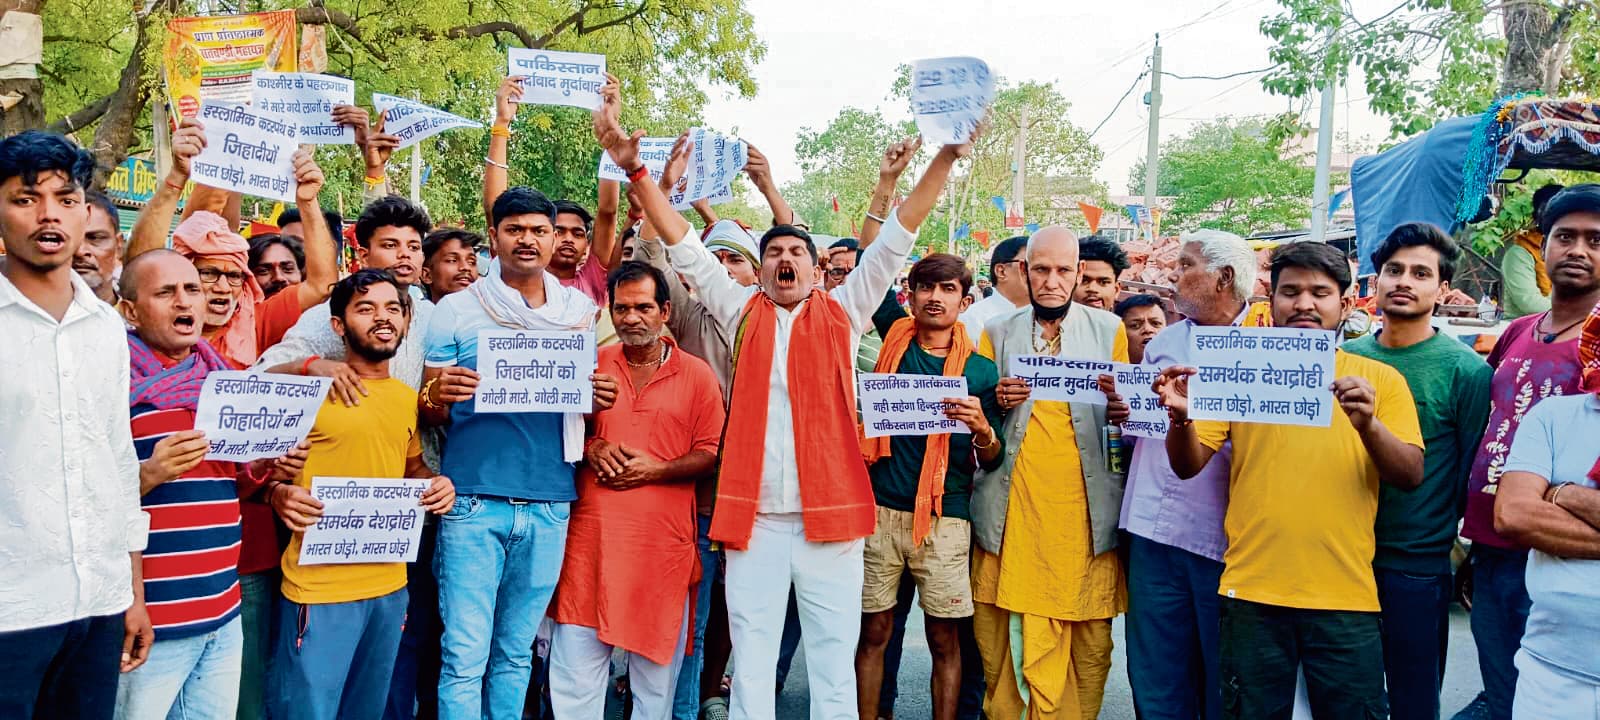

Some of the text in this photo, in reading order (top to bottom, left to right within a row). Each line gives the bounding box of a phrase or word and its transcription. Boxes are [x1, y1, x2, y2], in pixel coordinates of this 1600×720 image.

[516, 54, 600, 75] पाकिस्तान
[256, 75, 292, 89] काश्मीर
[294, 76, 304, 89] के
[204, 104, 257, 127] इस्लामिक
[288, 122, 297, 138] के
[223, 133, 279, 164] जिहादीयों
[194, 161, 219, 178] भारत
[249, 173, 270, 189] भारत
[272, 176, 289, 195] छोड़ो
[488, 333, 584, 351] इस्लामिक कटरपंथी
[1196, 330, 1330, 352] इस्लामिक कटरपंथ के
[495, 359, 576, 380] जिहादीयों को
[1117, 367, 1151, 385] काश्मिर
[1198, 361, 1324, 389] समर्थक देशद्रोही
[215, 375, 320, 398] इस्लामिक कटरपंथी
[864, 376, 960, 392] इस्लामिक आतंकवाद
[482, 388, 506, 404] गोली
[534, 387, 559, 404] गोली
[561, 389, 582, 404] मारो
[1129, 392, 1142, 410] के
[891, 400, 915, 413] सहेगा
[1194, 397, 1223, 410] भारत
[1259, 399, 1290, 415] भारत
[1294, 397, 1320, 420] छोड़ो
[218, 405, 303, 431] जिहादीयों को
[873, 419, 957, 431] पाकिस्तान हाय-हाय
[317, 480, 370, 500] इस्लामिक
[373, 483, 412, 499] कटरपंथ
[317, 509, 416, 531] समर्थक देशद्रोही
[306, 543, 332, 555] भारत
[362, 542, 386, 555] भारत
[389, 539, 410, 558] छोड़ो
